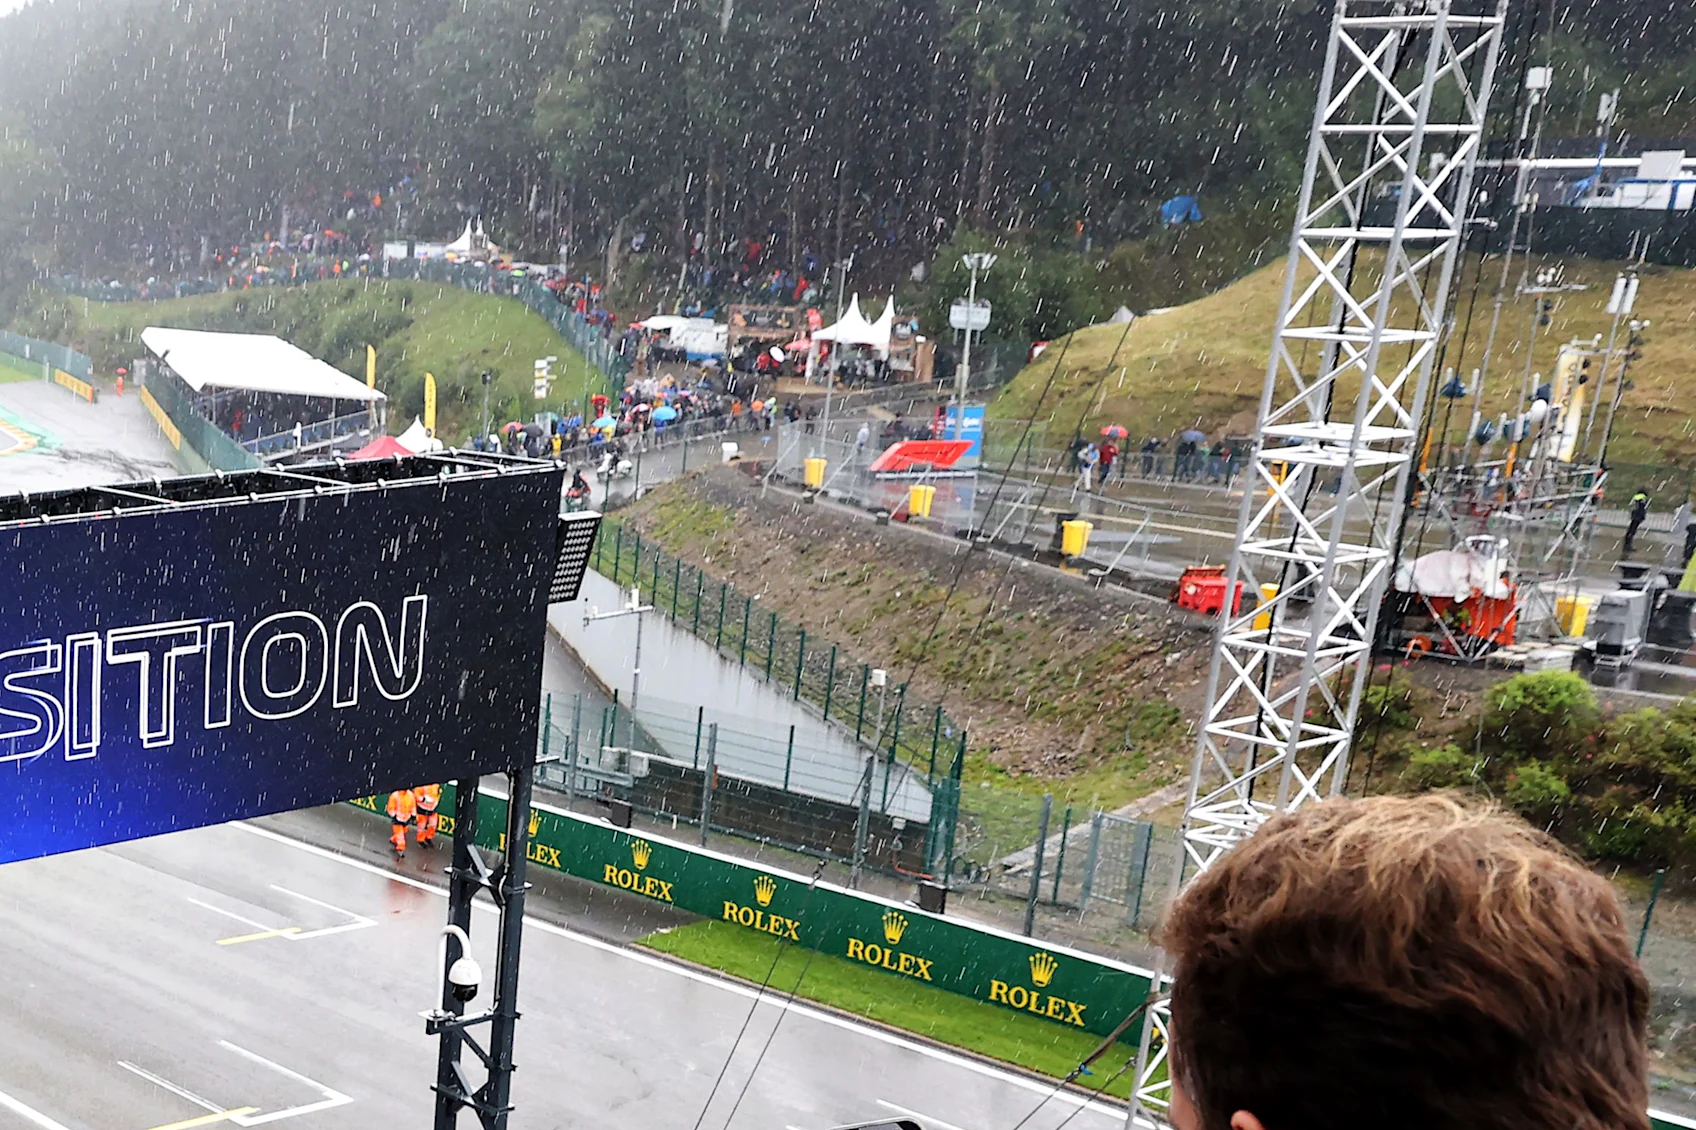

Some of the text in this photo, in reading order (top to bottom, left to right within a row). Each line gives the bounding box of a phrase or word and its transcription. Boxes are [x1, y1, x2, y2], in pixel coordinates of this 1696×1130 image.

[604, 863, 675, 902] ROLEX
[723, 900, 801, 941] ROLEX
[846, 938, 934, 981] ROLEX
[989, 979, 1088, 1027] ROLEX
